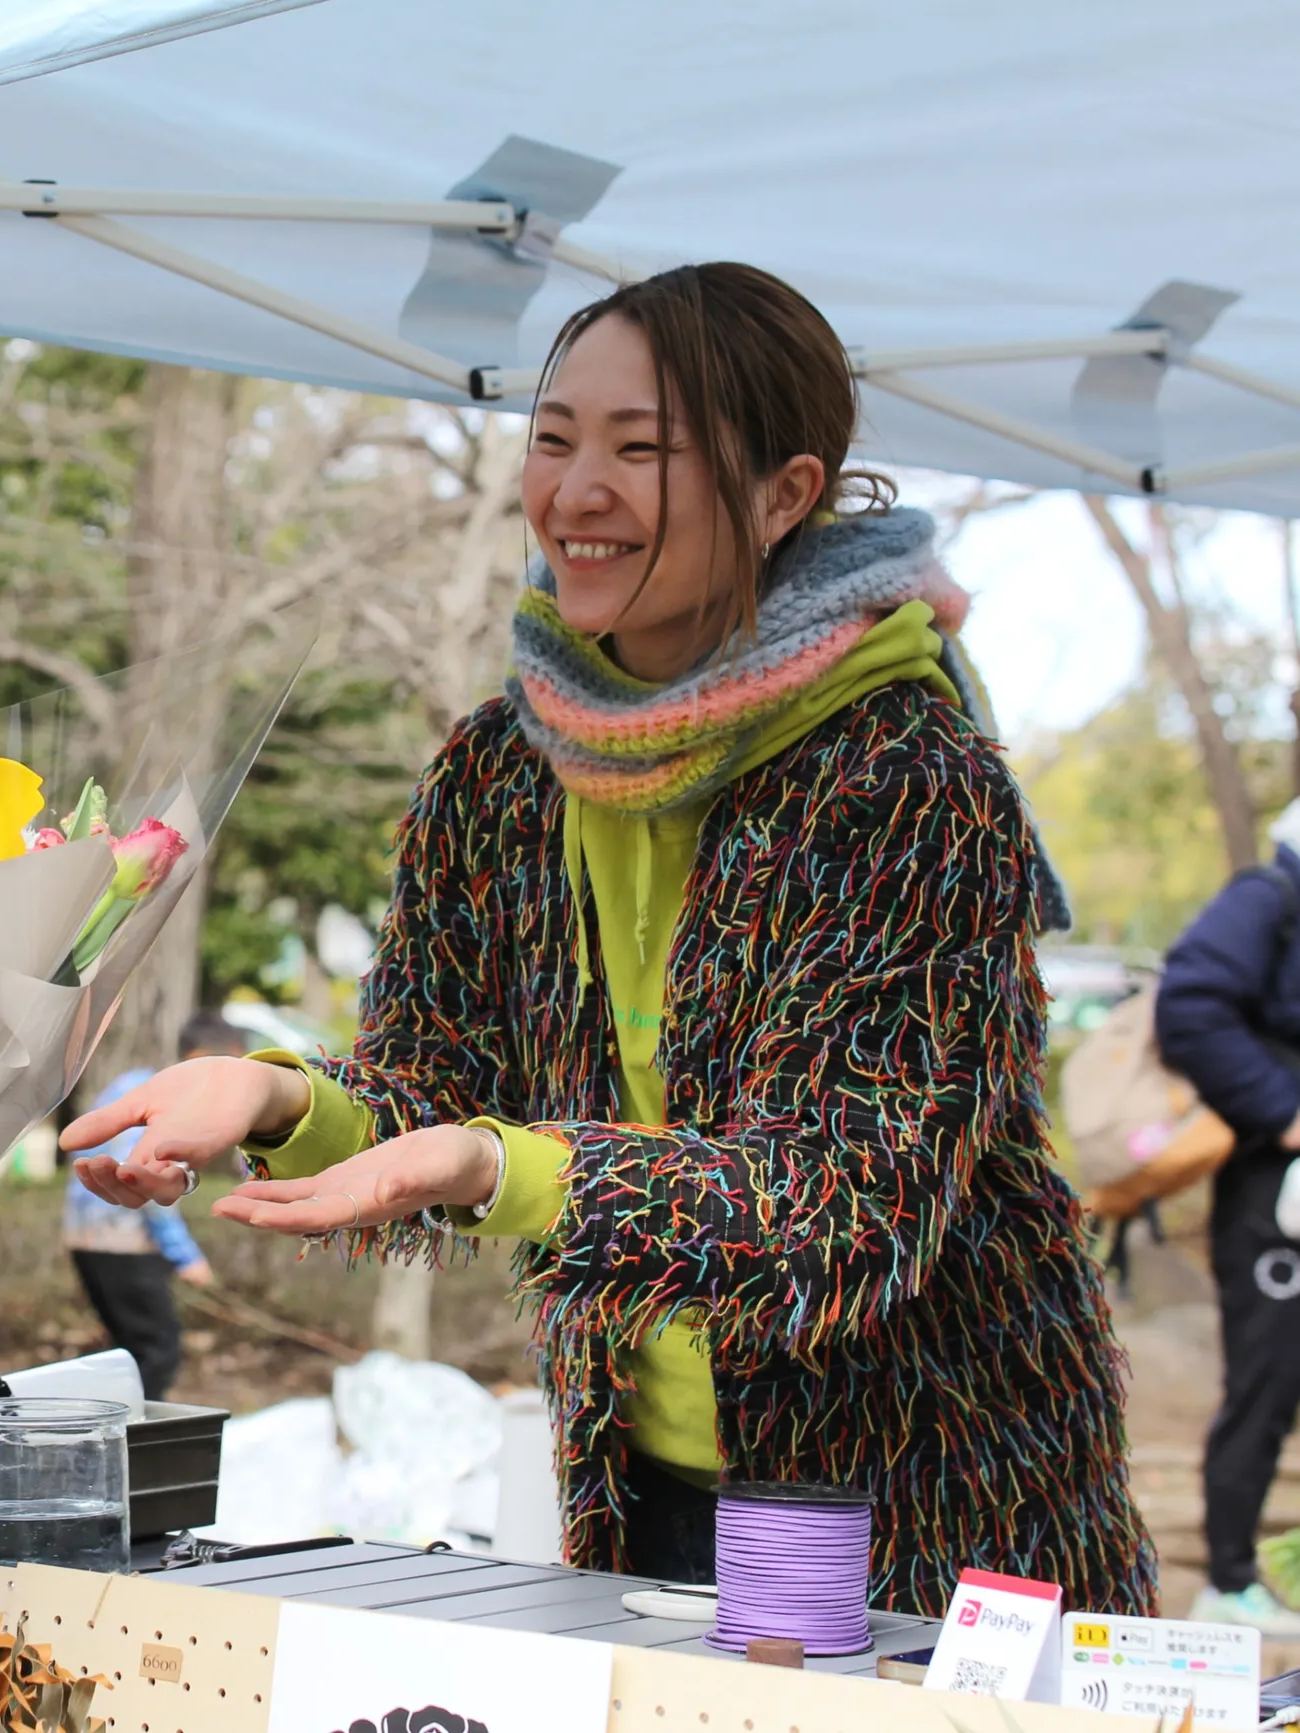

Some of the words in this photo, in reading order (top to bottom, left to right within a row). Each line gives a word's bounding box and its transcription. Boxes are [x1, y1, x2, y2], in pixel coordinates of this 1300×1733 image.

[980, 1608, 1033, 1636] PayPay
[143, 1654, 177, 1671] 6600
[1121, 1700, 1228, 1720] ご利用いたけます
